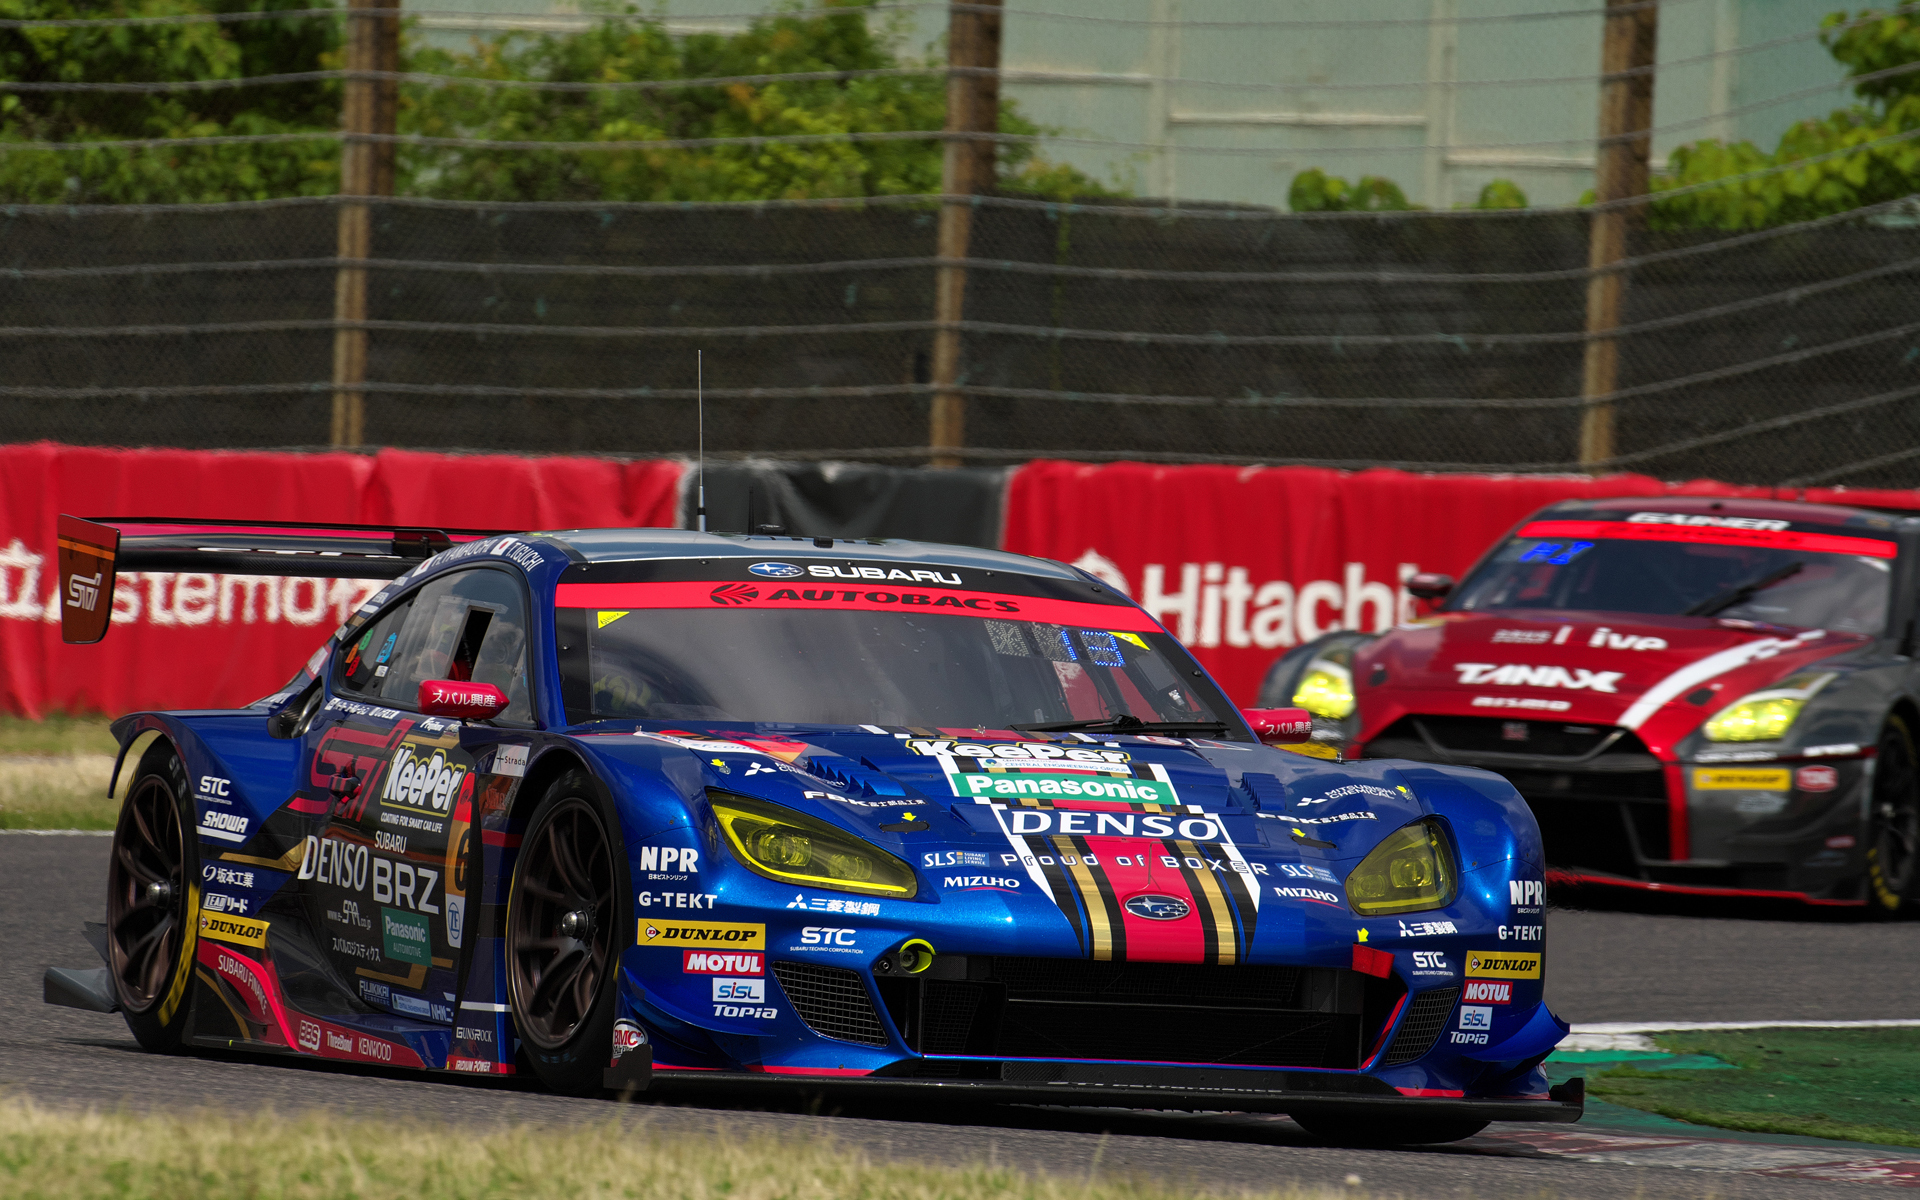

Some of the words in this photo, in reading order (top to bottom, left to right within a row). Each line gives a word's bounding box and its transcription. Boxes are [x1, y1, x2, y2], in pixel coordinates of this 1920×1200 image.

[506, 542, 545, 572] T.IGUCHI
[807, 565, 962, 585] SUBARU
[765, 589, 1020, 612] AUTOBACS
[1143, 562, 1418, 648] Hitachi
[432, 692, 497, 707] スバル興産
[1265, 721, 1312, 736] スバル興産
[504, 755, 526, 766] Strada
[908, 739, 1128, 764] KeePer
[199, 775, 231, 797] STC
[382, 746, 464, 813] KeePer
[965, 775, 1159, 801] Panasonic
[202, 810, 249, 833] SHOWA
[381, 812, 399, 825] COATING
[399, 815, 408, 827] FOR
[408, 817, 423, 829] SMART
[423, 820, 432, 831] CAR
[432, 822, 443, 833] LIFE
[1011, 811, 1219, 840] DENSO
[375, 830, 407, 854] SUBARU
[297, 835, 369, 892] DENSO
[640, 846, 699, 873] NPR
[924, 851, 956, 867] SLS
[1001, 854, 1099, 867] Proud
[1115, 854, 1145, 867] of
[1158, 855, 1270, 875] BOXER
[1281, 864, 1314, 878] SLS
[373, 857, 439, 915] BRZ
[944, 876, 1020, 888] MIZUHO
[638, 891, 718, 909] G-TEKT
[1273, 887, 1339, 903] MIZUHO
[1509, 880, 1544, 906] NPR
[808, 898, 880, 917] 三菱製鋼
[208, 919, 264, 939] DUNLOP
[385, 915, 426, 943] Panasonic
[448, 909, 460, 932] ZF
[662, 927, 757, 942] DUNLOP
[800, 926, 856, 946] STC
[1498, 925, 1543, 941] G-TEKT
[686, 953, 762, 973] MOTUL
[1412, 951, 1447, 968] STC
[1482, 958, 1537, 972] DUNLOP
[218, 954, 248, 983] SUBARU
[247, 974, 268, 1015] FINANCE
[1464, 983, 1511, 1002] MOTUL
[614, 1029, 639, 1046] BMC
[358, 1037, 392, 1061] KENWOOD
[472, 1061, 491, 1073] POWER
